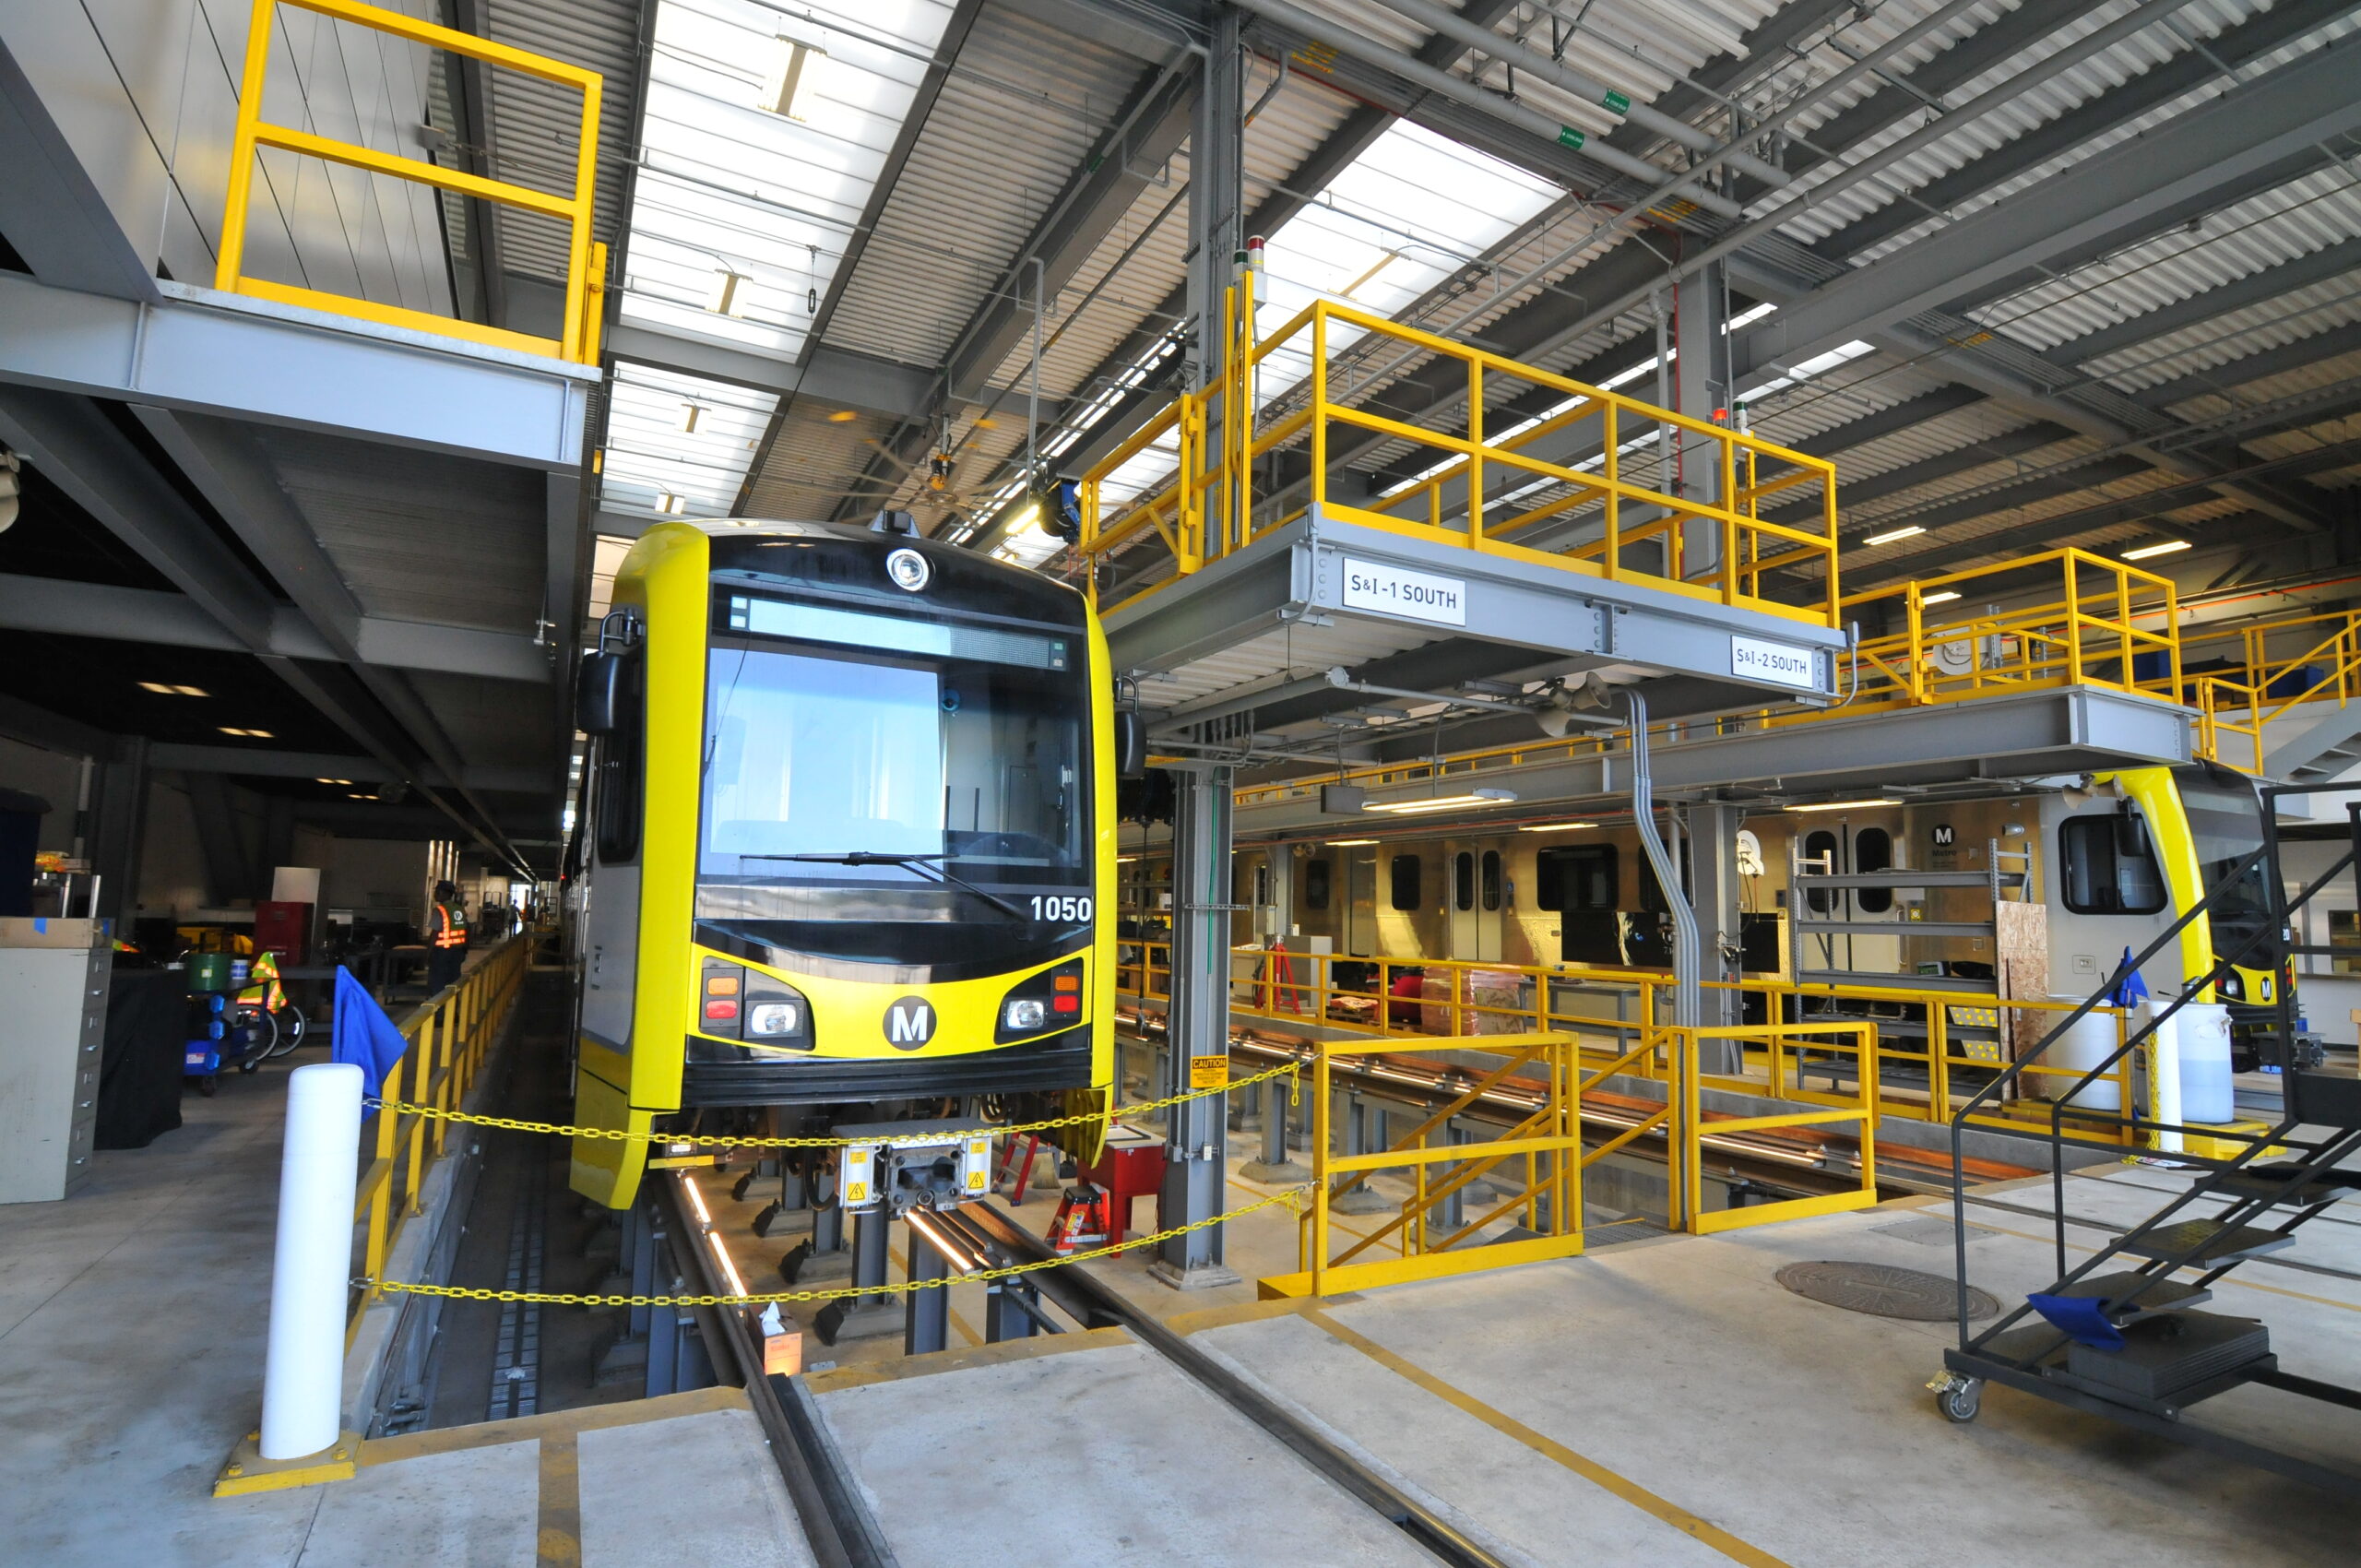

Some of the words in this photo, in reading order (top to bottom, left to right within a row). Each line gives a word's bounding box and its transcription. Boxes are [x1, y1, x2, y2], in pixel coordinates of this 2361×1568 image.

[1403, 584, 1456, 610] SOUTH
[1772, 655, 1807, 675] SOUTH
[1935, 827, 1952, 844] M
[1030, 896, 1092, 922] 1050
[892, 1005, 929, 1042] M
[1192, 1059, 1226, 1068] CAUTION
